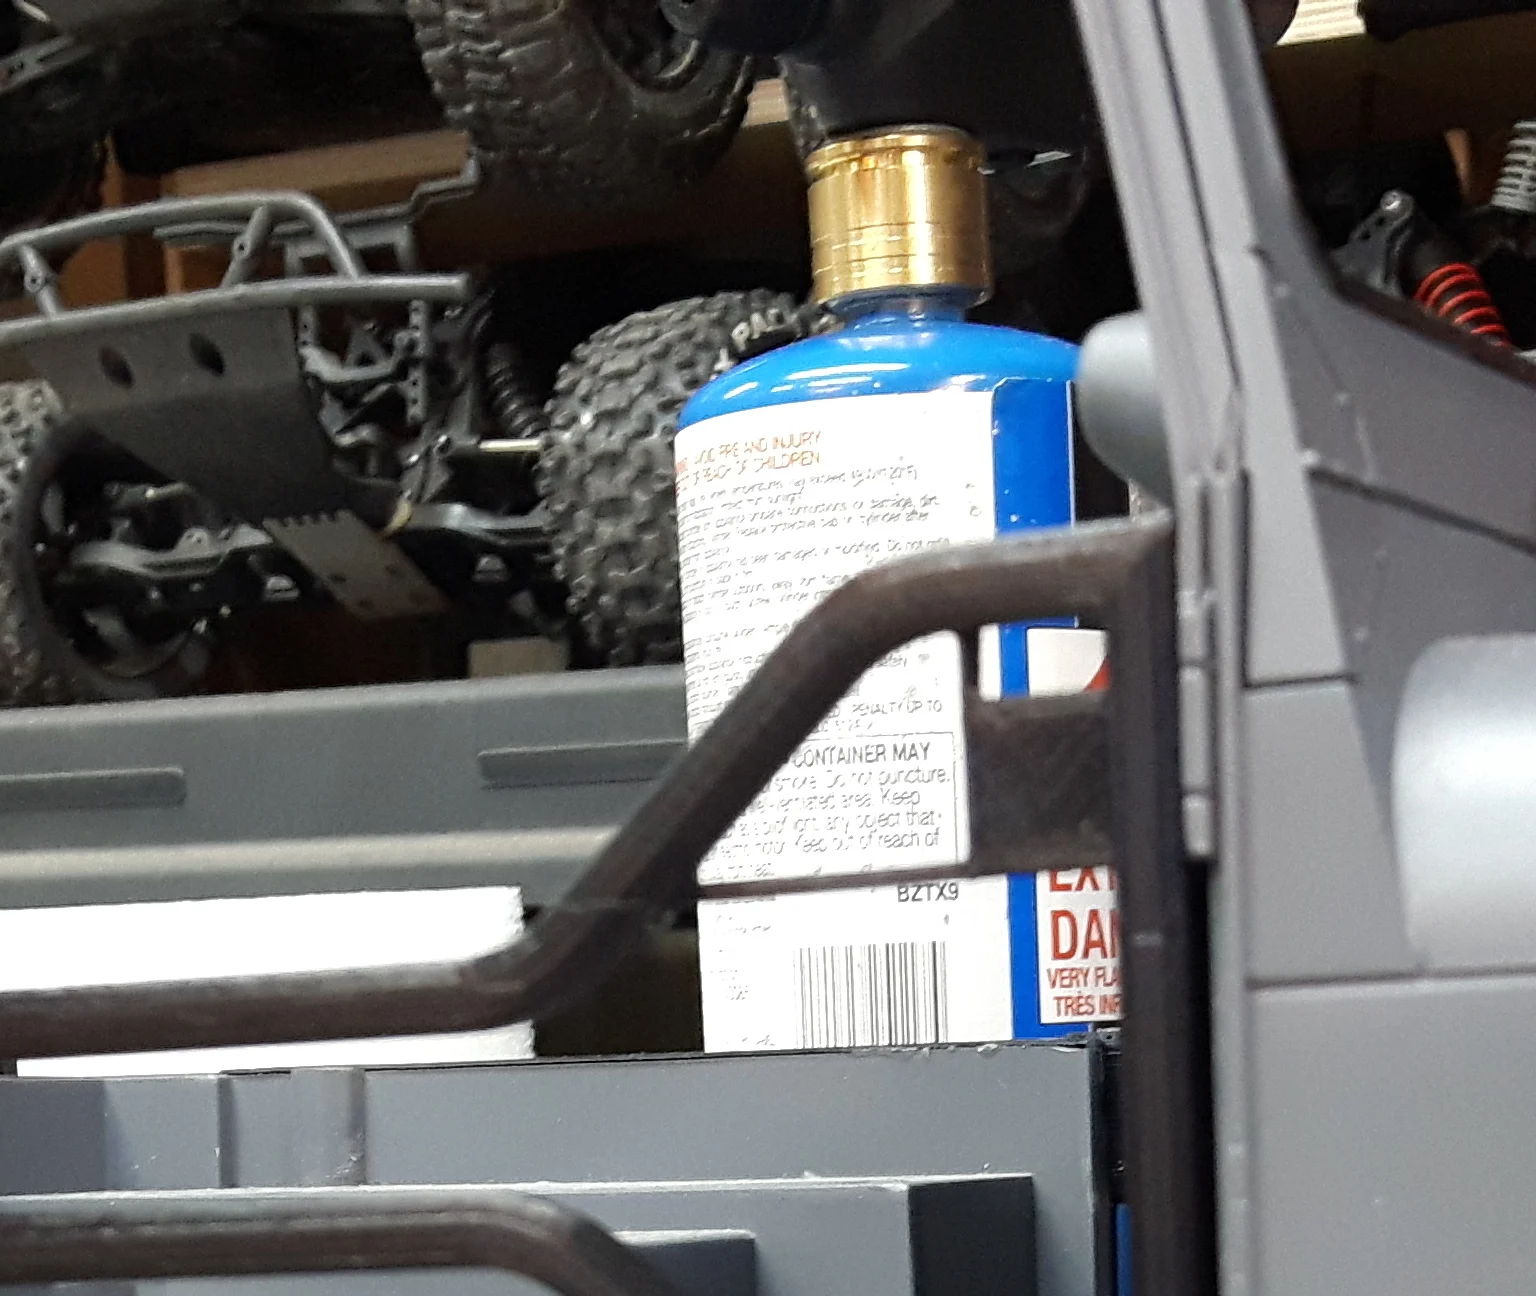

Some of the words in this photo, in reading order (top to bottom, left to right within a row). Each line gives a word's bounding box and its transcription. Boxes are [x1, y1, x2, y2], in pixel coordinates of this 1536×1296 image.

[771, 430, 823, 451] INJURY
[794, 744, 887, 768] CONTAINER
[892, 741, 932, 762] MAY
[878, 766, 951, 787] puncture.
[879, 786, 922, 806] Keep
[877, 826, 921, 848] reach
[897, 882, 960, 903] BZTX9
[1046, 966, 1090, 990] VERY
[1052, 989, 1096, 1018] TRÈS
